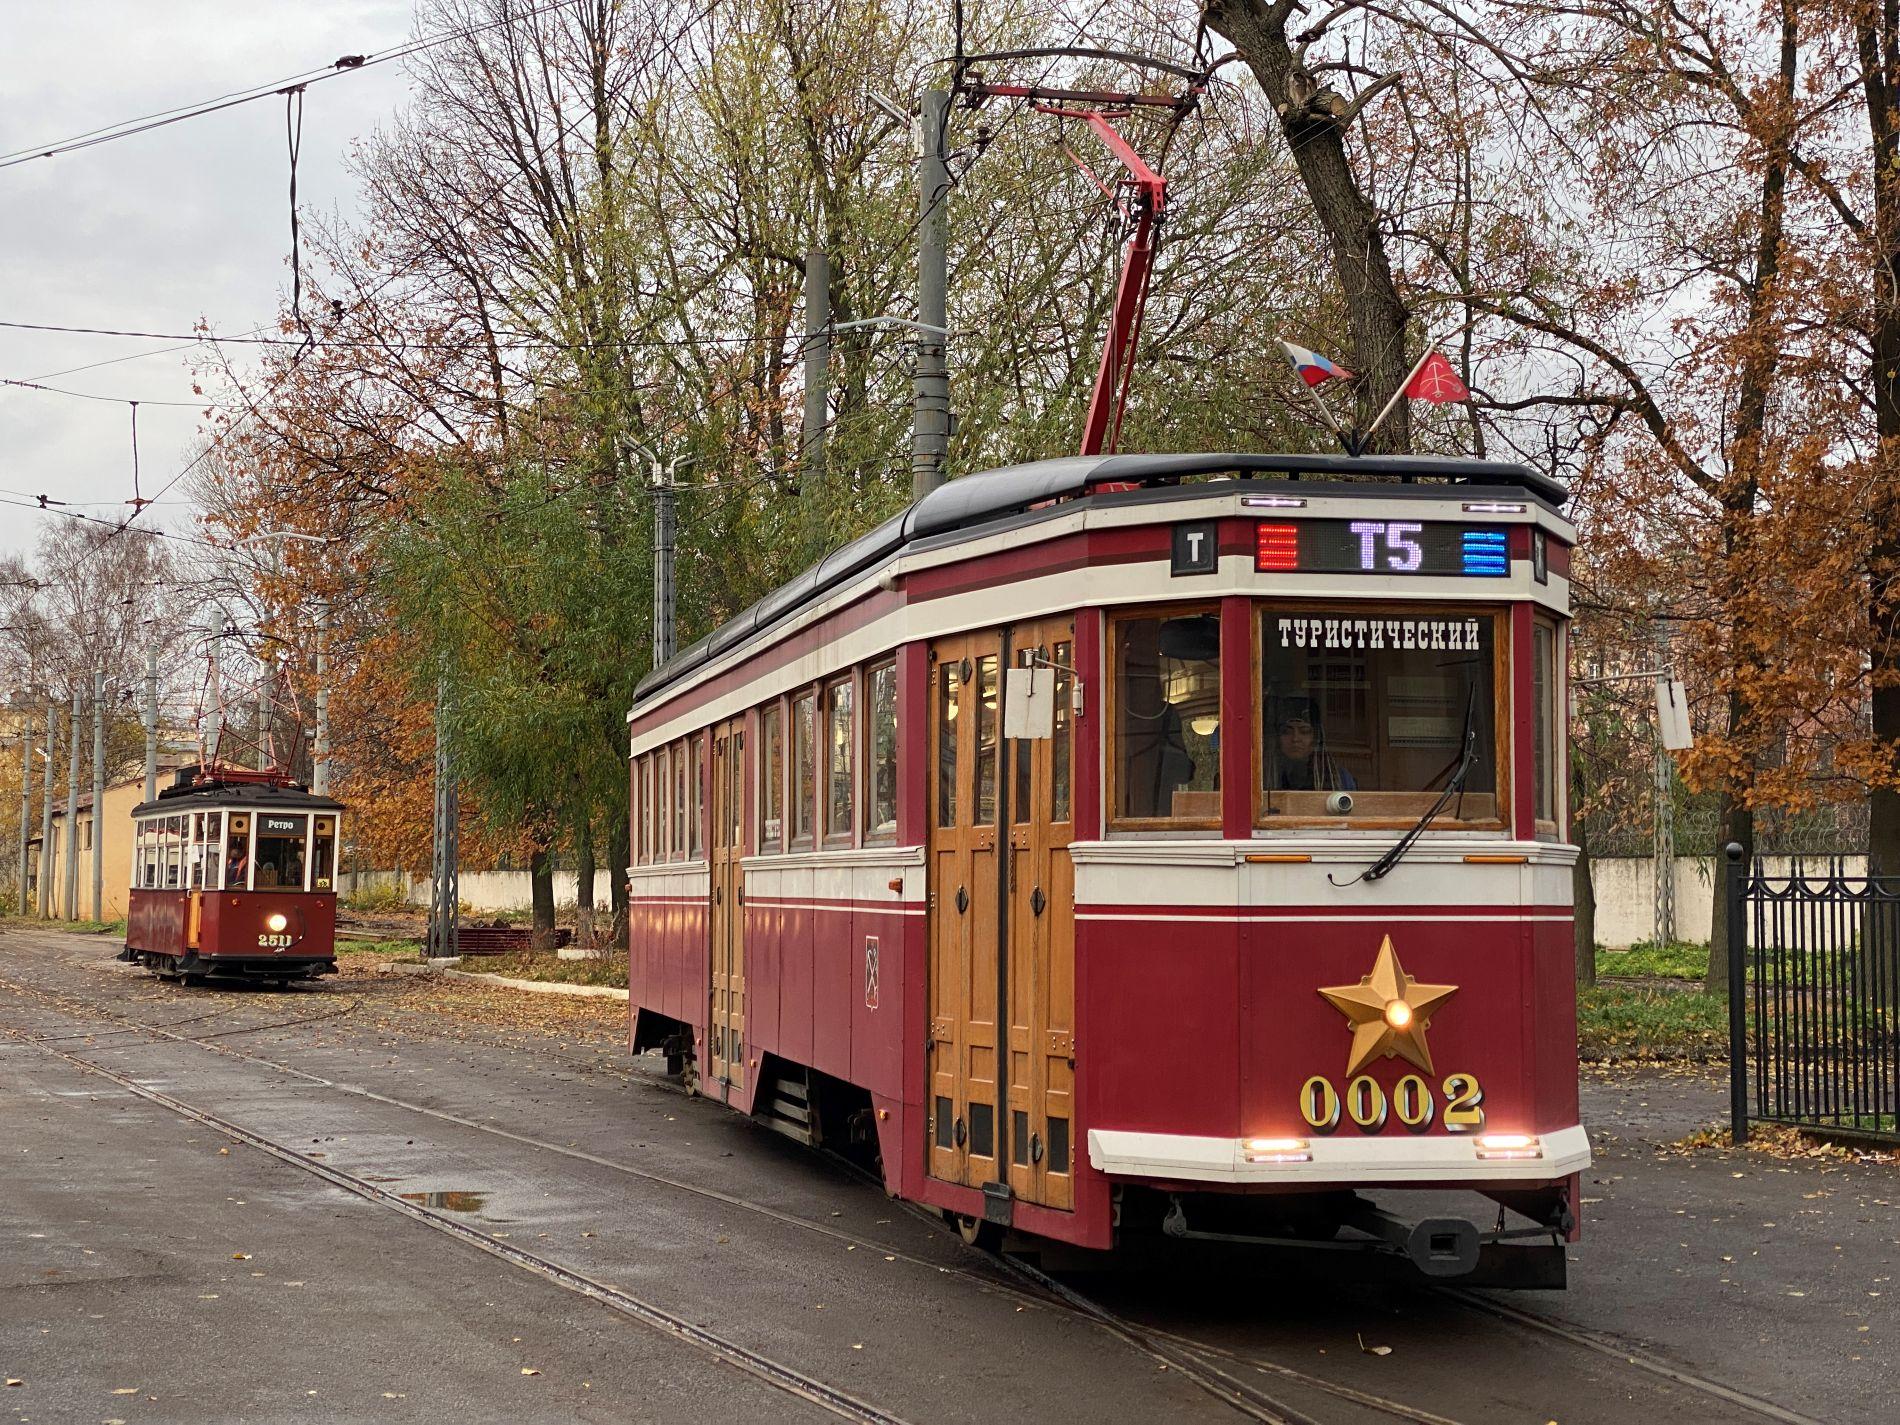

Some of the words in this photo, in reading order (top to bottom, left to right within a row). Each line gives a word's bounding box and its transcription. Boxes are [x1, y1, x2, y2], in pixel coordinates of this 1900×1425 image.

[1278, 617, 1480, 650] ТУРИСТИЧЕСКИЙ
[268, 819, 294, 830] Ретро
[258, 934, 292, 947] 2511
[1300, 1073, 1483, 1129] 0002
